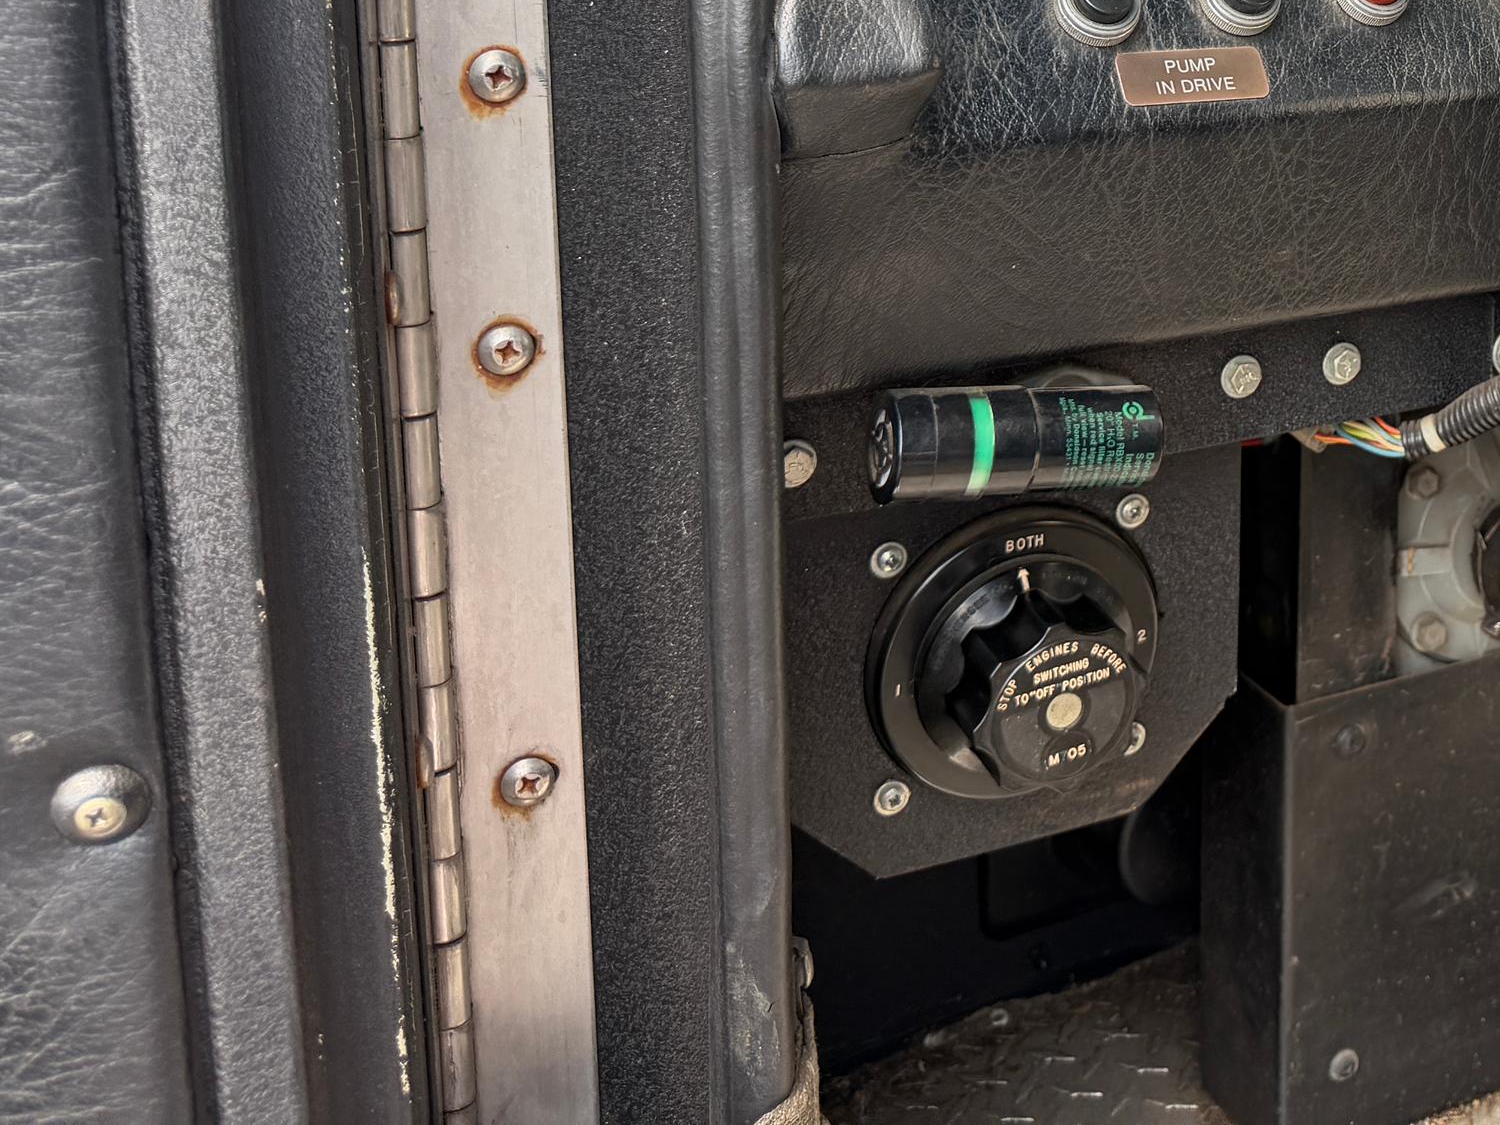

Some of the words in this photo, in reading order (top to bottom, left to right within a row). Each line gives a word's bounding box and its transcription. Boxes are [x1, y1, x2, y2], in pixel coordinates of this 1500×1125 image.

[1164, 57, 1217, 74] PUMP
[1155, 81, 1176, 95] IN
[1180, 76, 1237, 94] DRIVE
[1005, 533, 1045, 553] BOTH
[1136, 629, 1147, 643] 2
[996, 679, 1018, 712] STOP
[1025, 641, 1079, 672] ENGINES
[1090, 643, 1127, 674] BEFORE
[1033, 657, 1090, 685] SWITCHING
[1014, 693, 1029, 707] TO
[1061, 667, 1110, 692] POSITION
